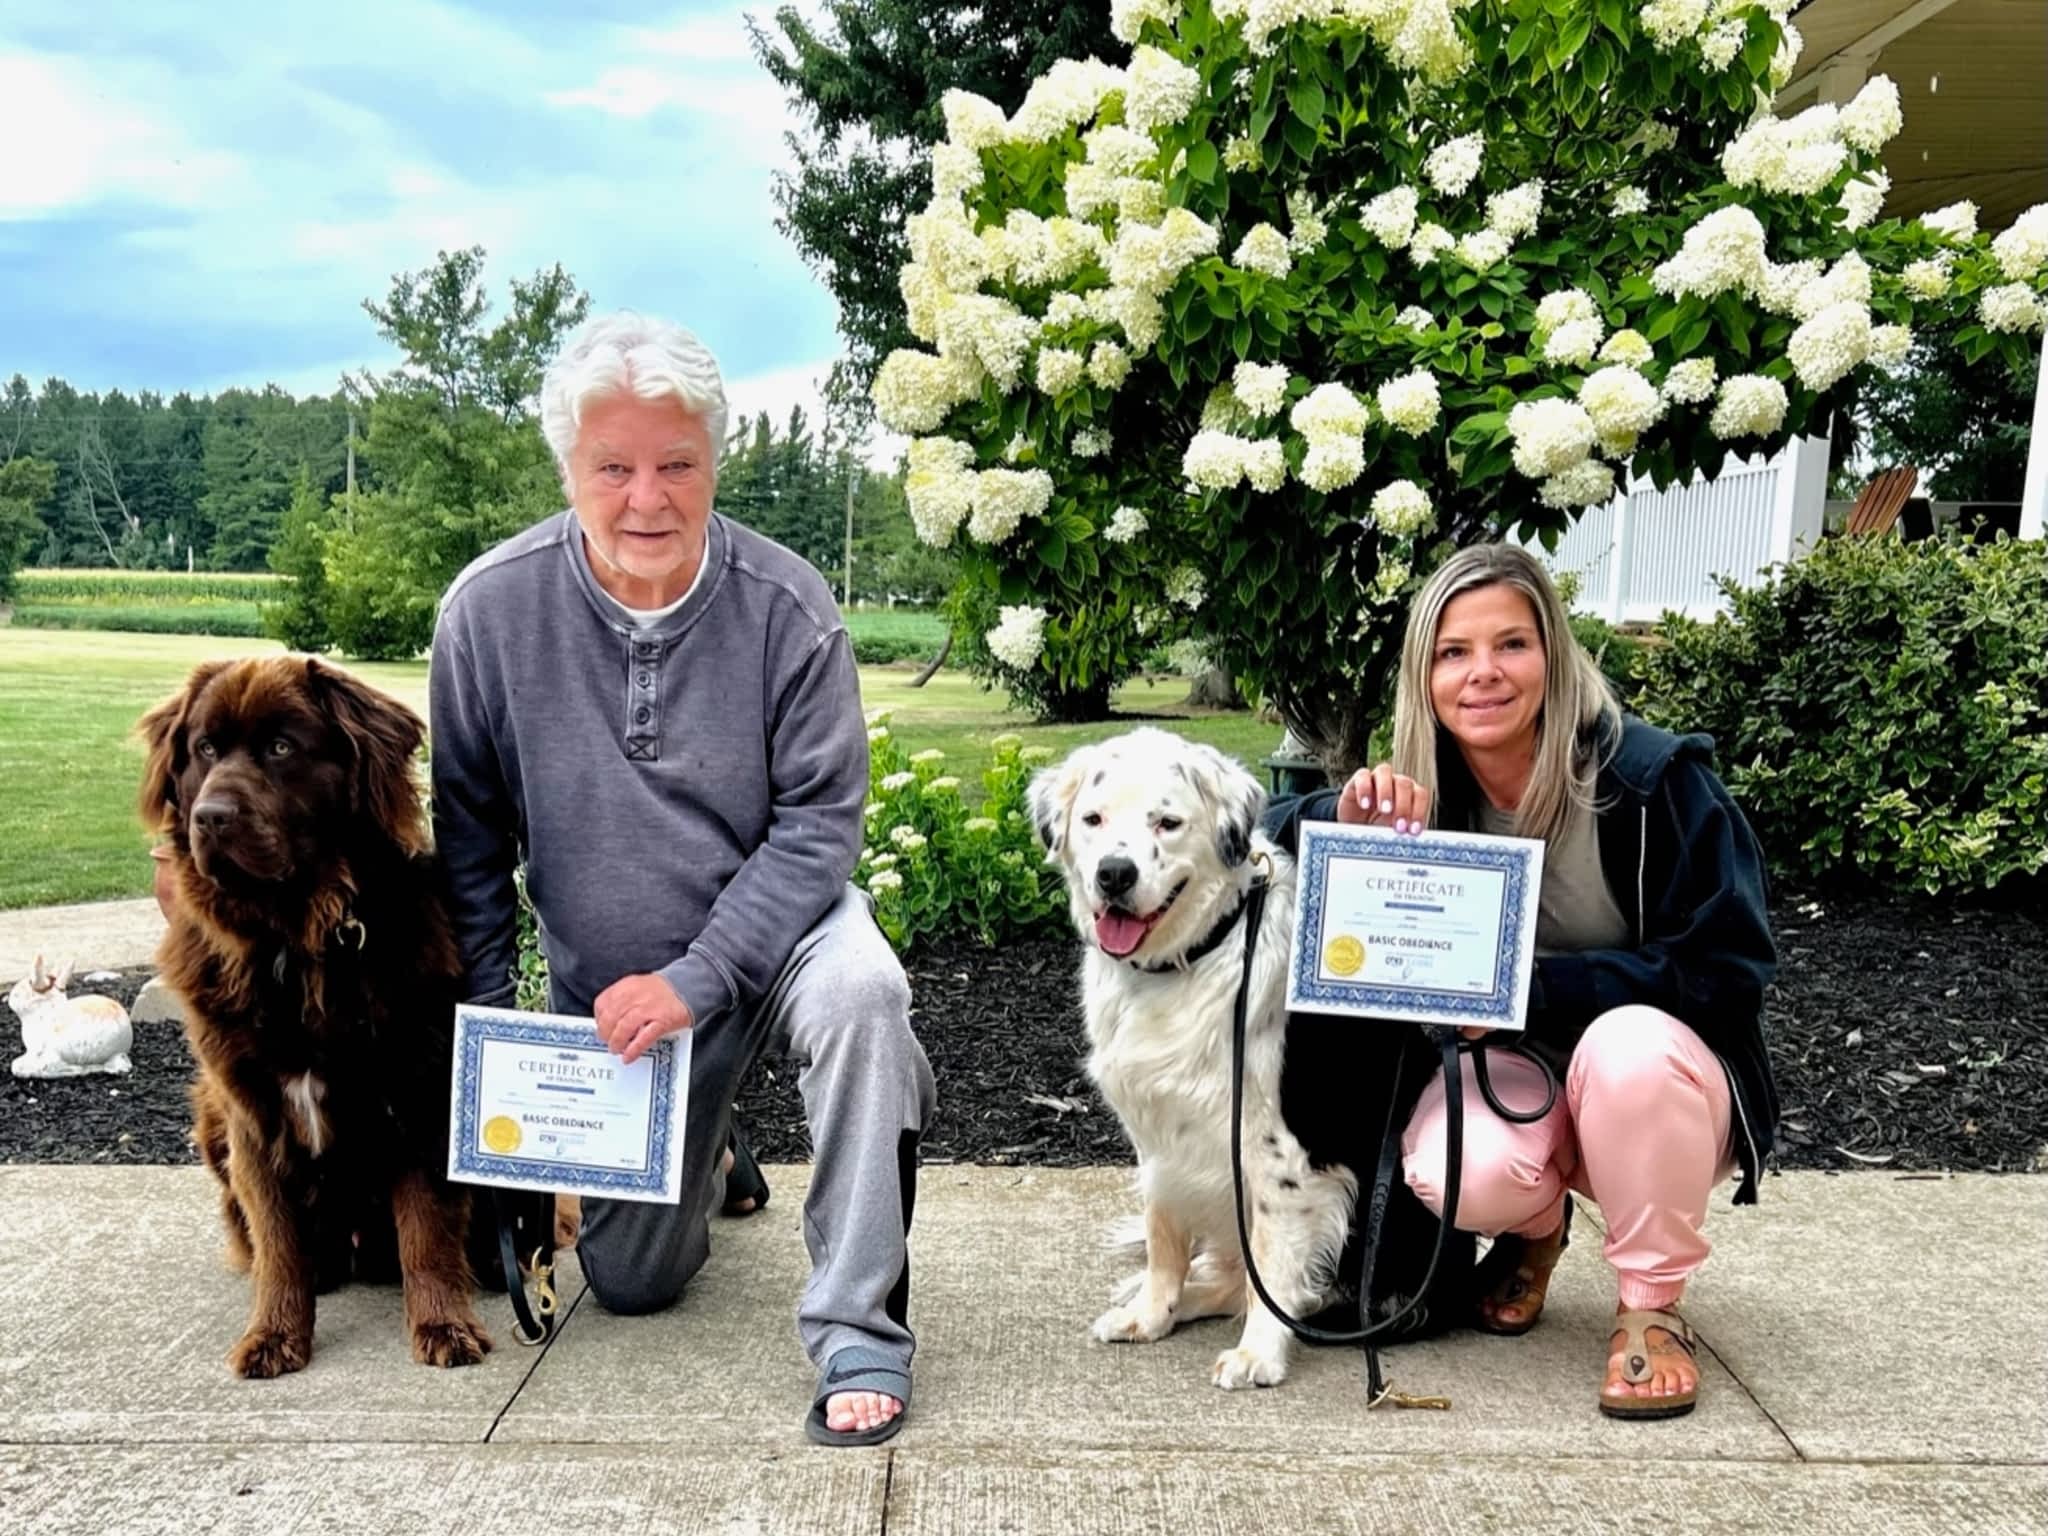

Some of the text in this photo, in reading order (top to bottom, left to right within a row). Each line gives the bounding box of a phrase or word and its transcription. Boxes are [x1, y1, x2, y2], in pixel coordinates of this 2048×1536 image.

[1366, 877, 1464, 897] CERTIFICATE
[1368, 935, 1397, 946] BASIC
[518, 1060, 614, 1080] CERTIFICATE
[522, 1113, 550, 1125] BASIC
